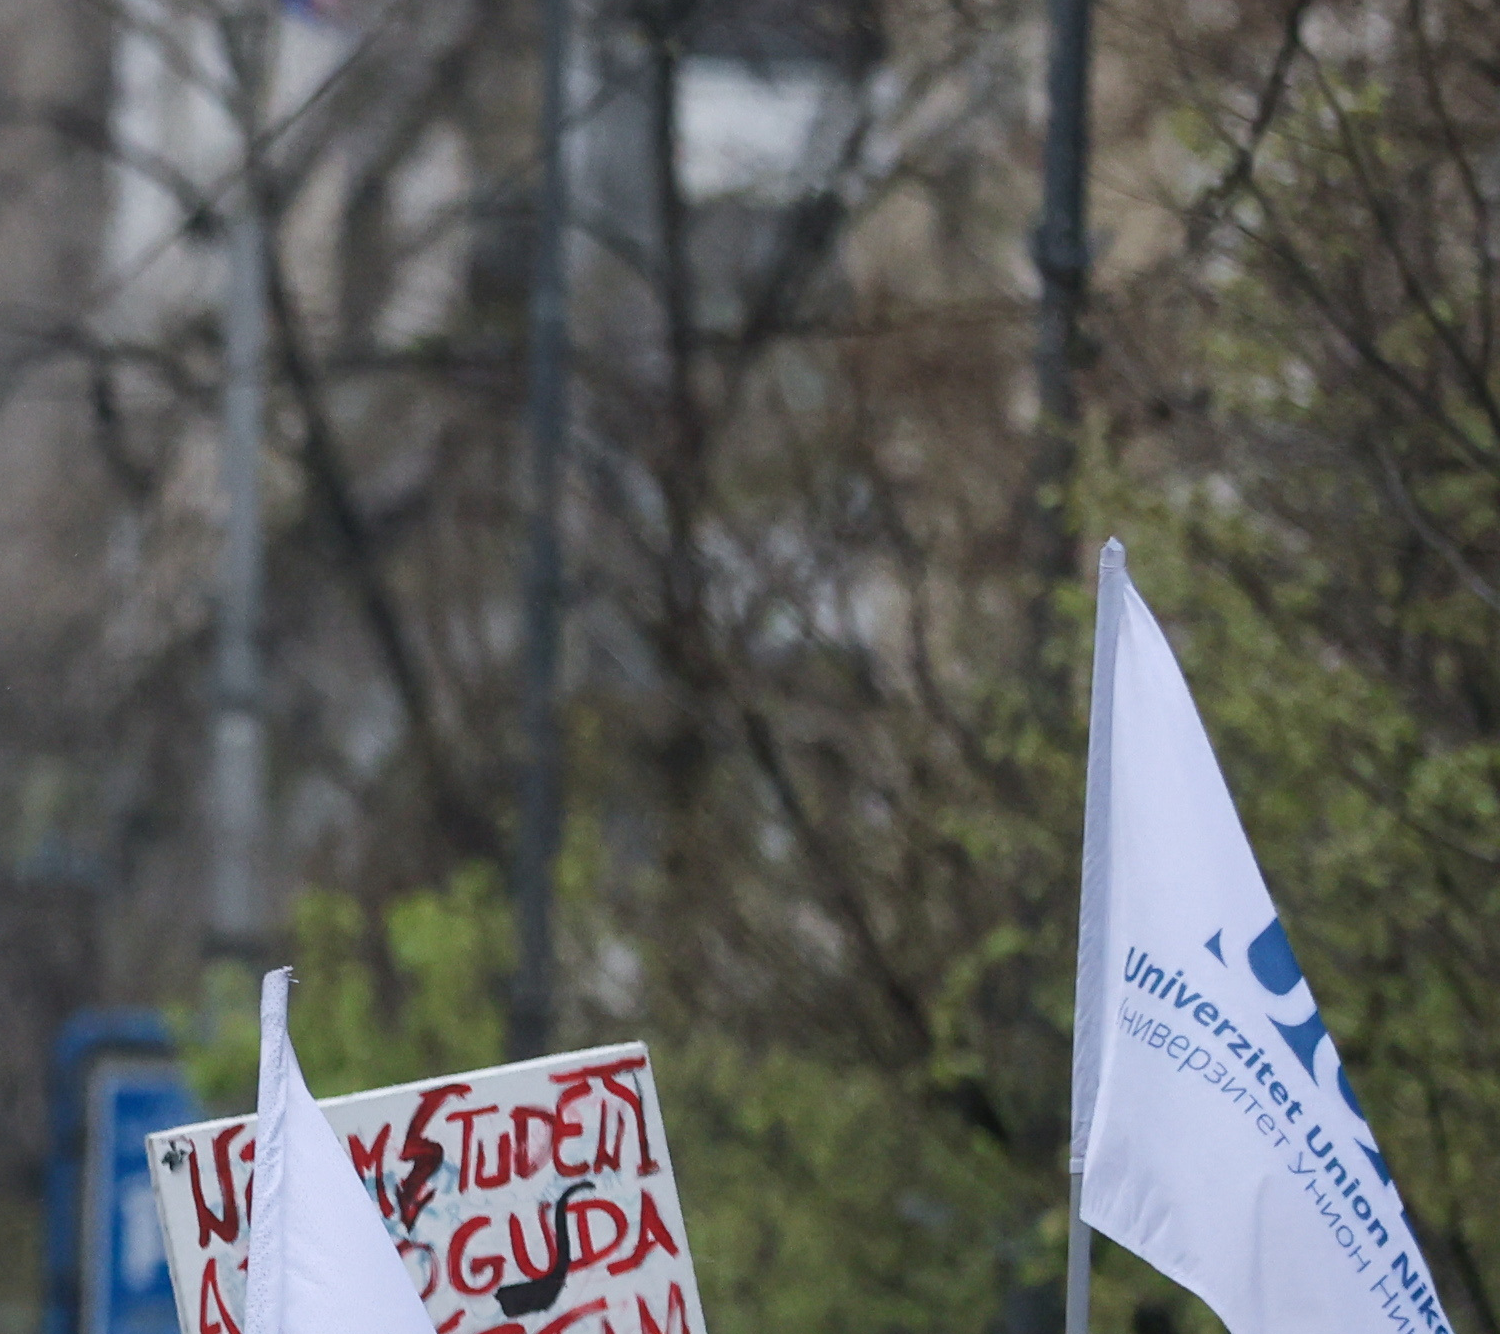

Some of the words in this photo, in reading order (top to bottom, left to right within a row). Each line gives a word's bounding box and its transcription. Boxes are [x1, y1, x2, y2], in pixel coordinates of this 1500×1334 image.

[1117, 997, 1292, 1149] ниверзитет
[1125, 945, 1305, 1125] Univerzitet
[1305, 1124, 1390, 1248] Union
